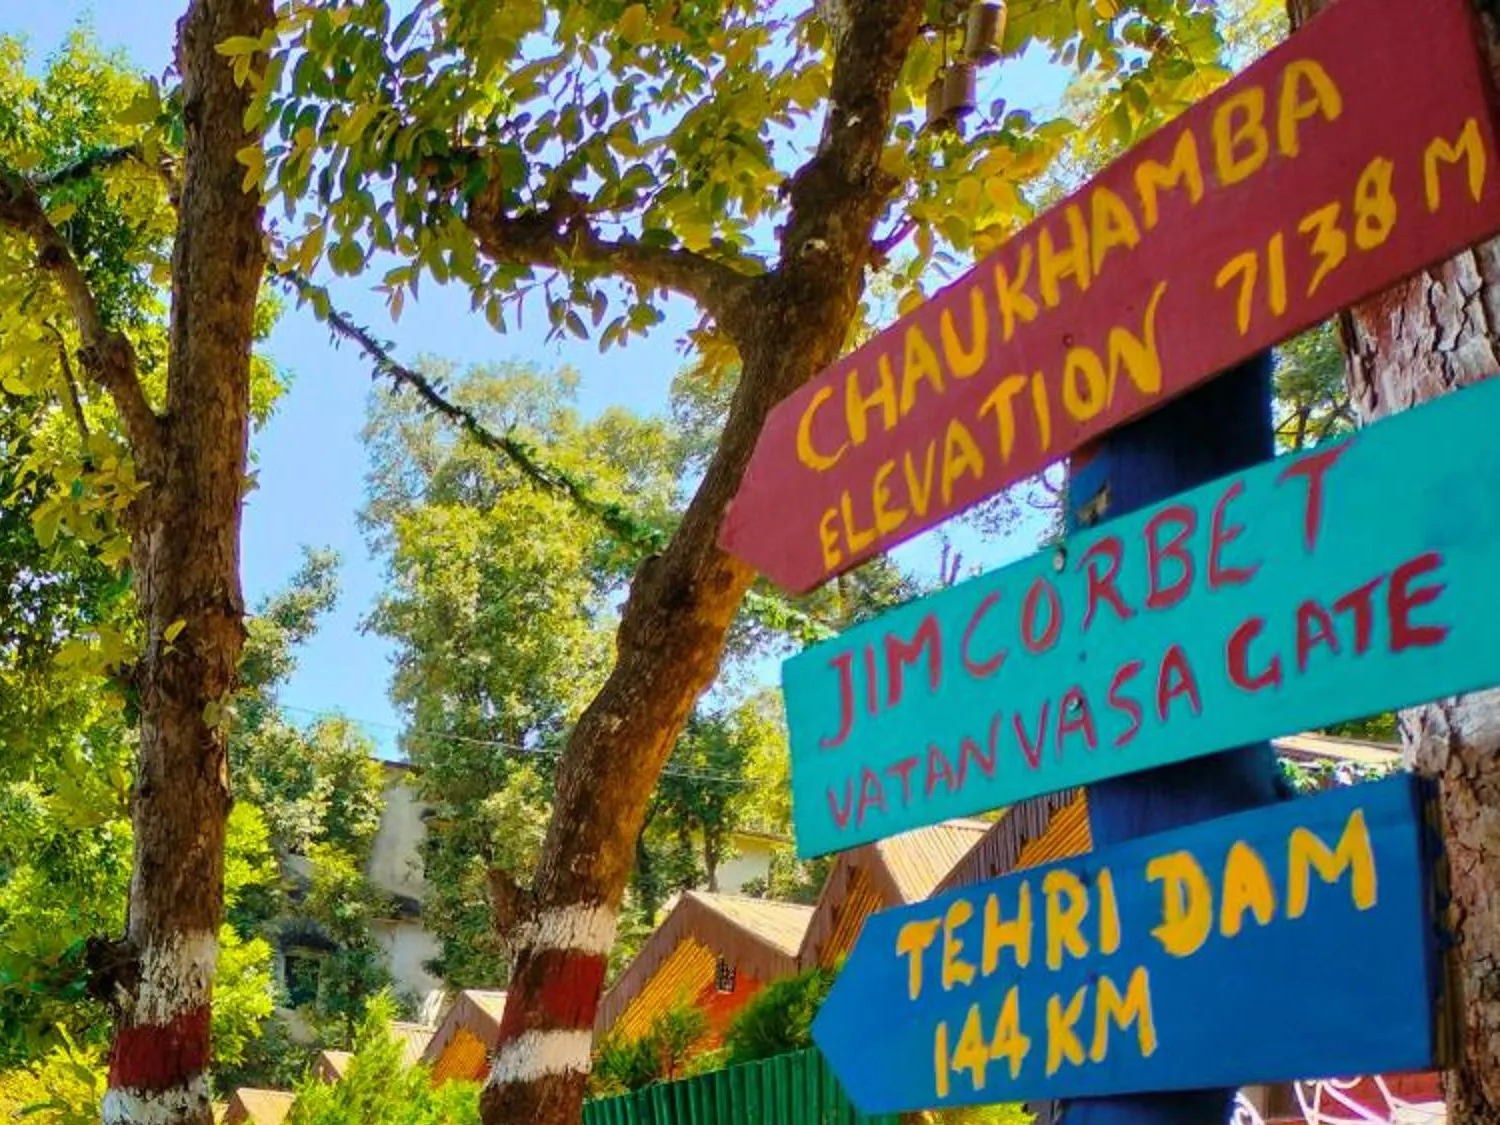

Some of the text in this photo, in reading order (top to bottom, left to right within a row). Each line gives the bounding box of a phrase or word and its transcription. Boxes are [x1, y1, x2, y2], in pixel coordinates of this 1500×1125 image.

[798, 58, 1342, 471] CHAUKHAMBA
[819, 117, 1486, 571] ELEVATION 7138 M
[826, 551, 1447, 832] VATANVASA GATE
[895, 808, 1377, 999] TEHRI DAM
